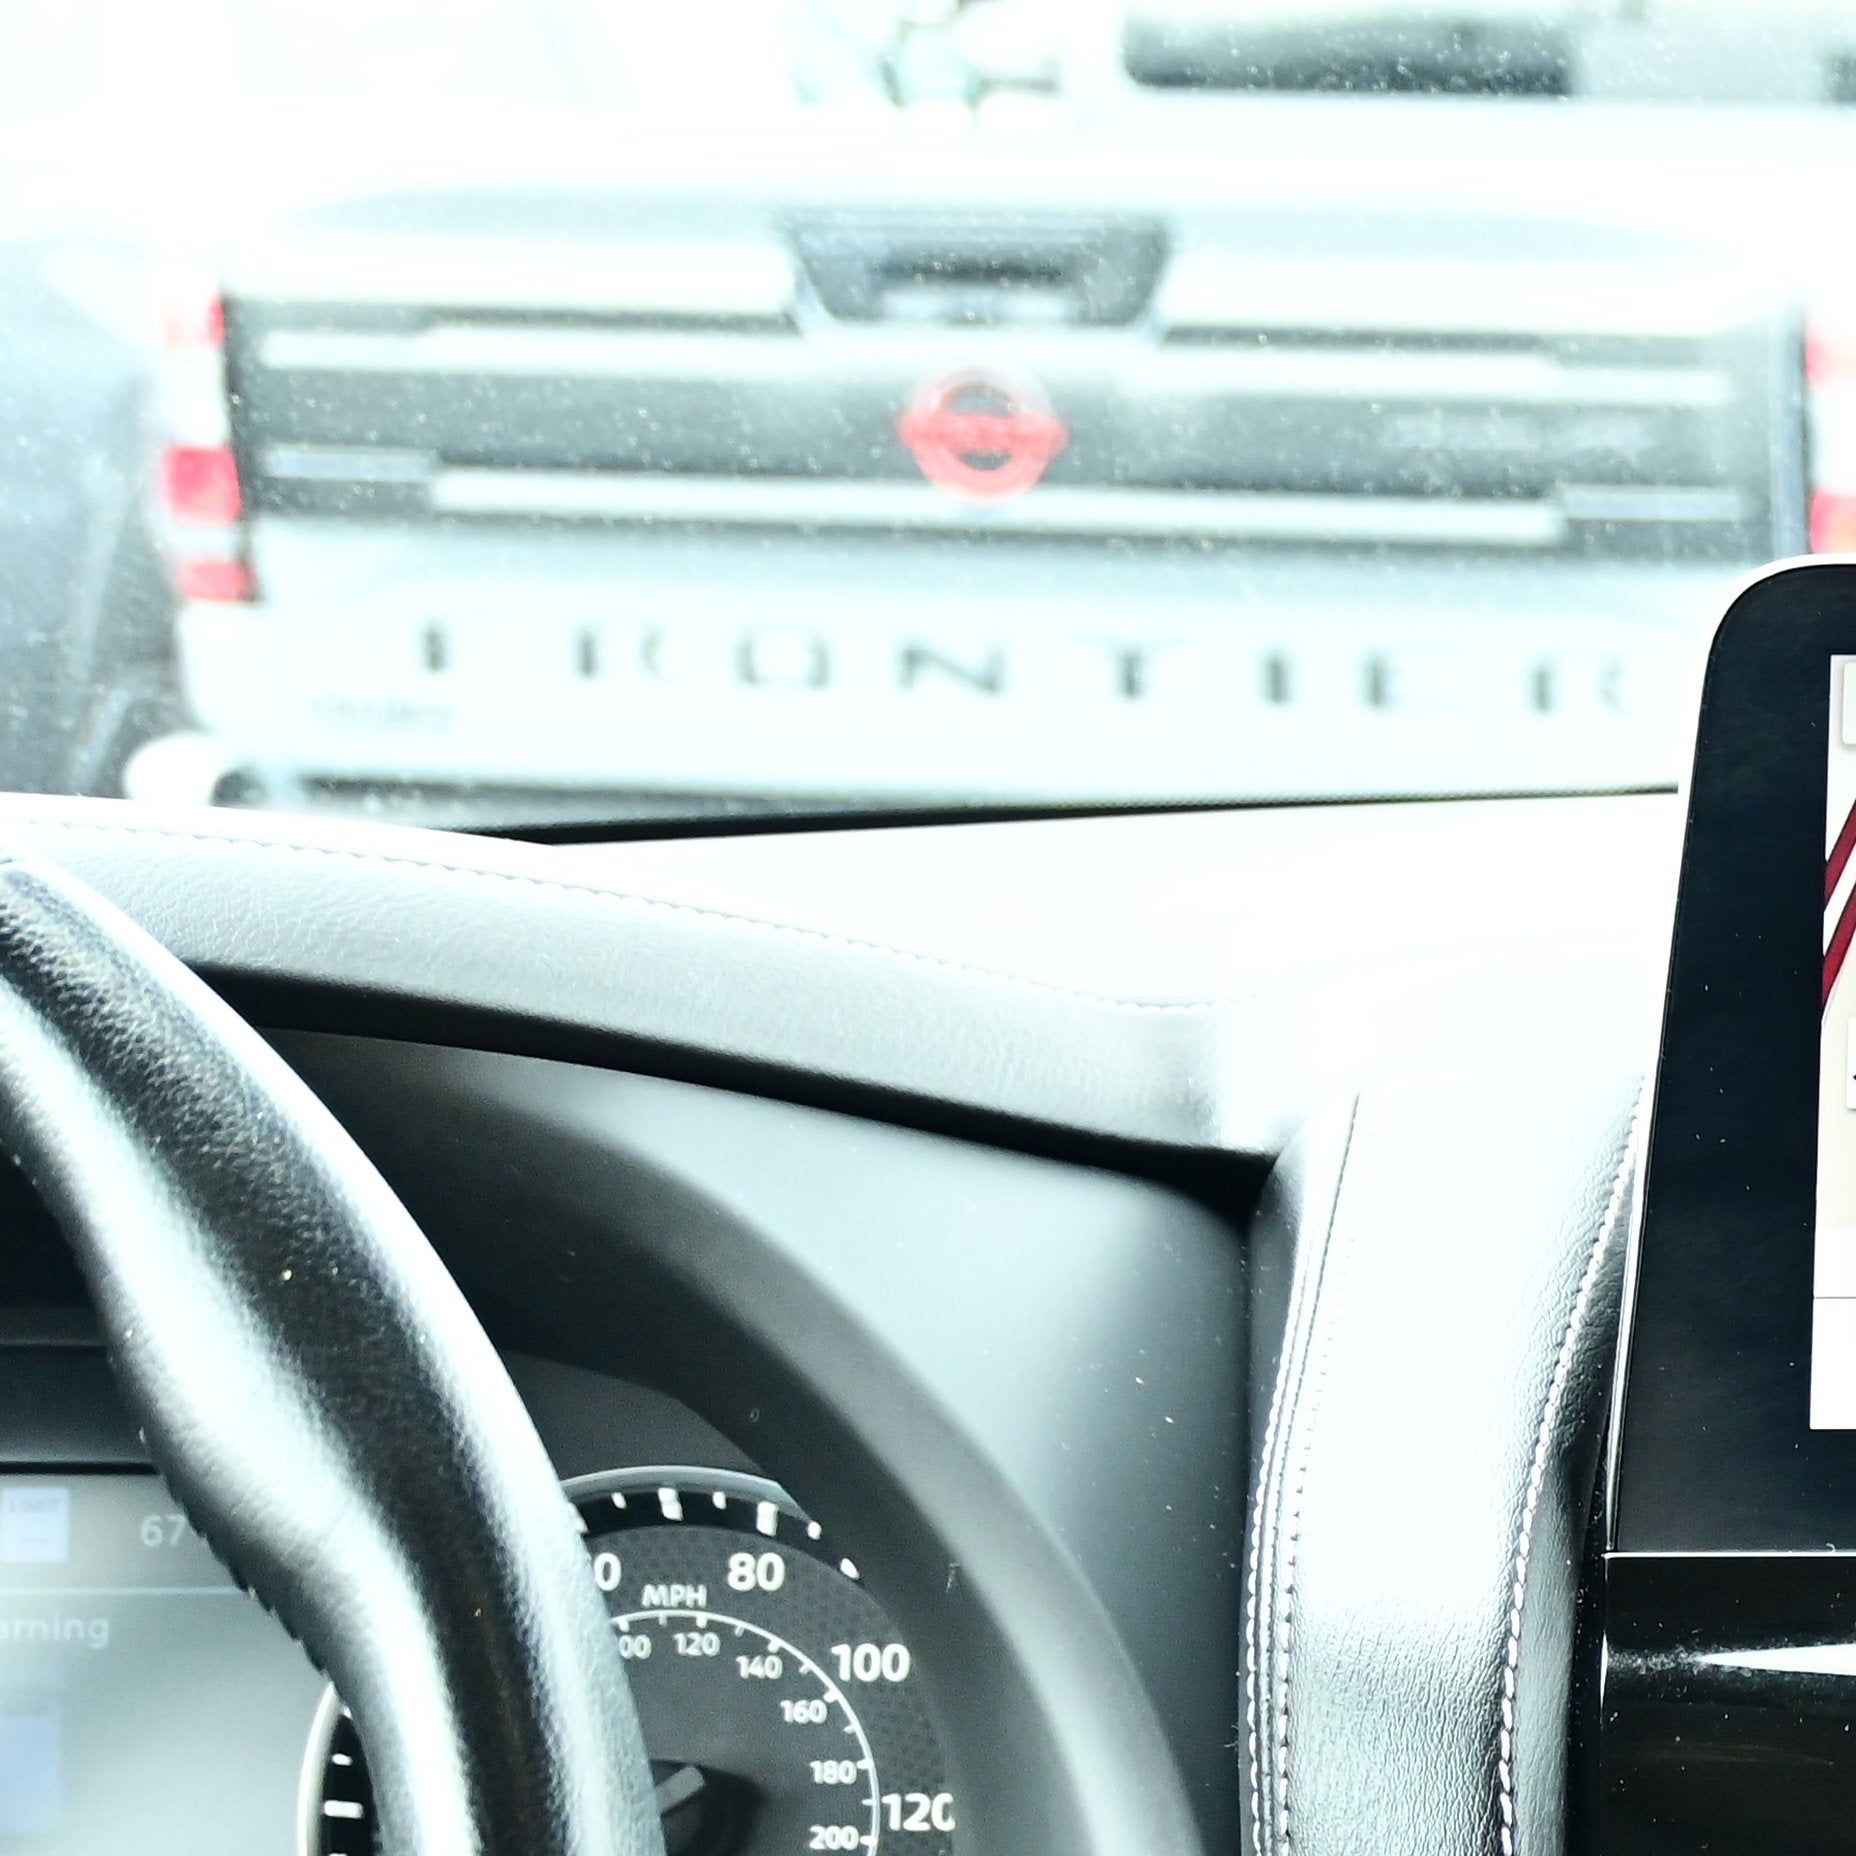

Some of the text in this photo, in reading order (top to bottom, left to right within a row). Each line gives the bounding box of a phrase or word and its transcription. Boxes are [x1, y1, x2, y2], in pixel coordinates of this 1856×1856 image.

[727, 1552, 786, 1592] 80
[641, 1584, 708, 1608] MPH
[674, 1631, 721, 1657] 120
[736, 1655, 783, 1680] 140
[831, 1643, 911, 1683] 100
[780, 1699, 828, 1724] 160
[810, 1759, 857, 1785] 180
[809, 1825, 860, 1851] 200
